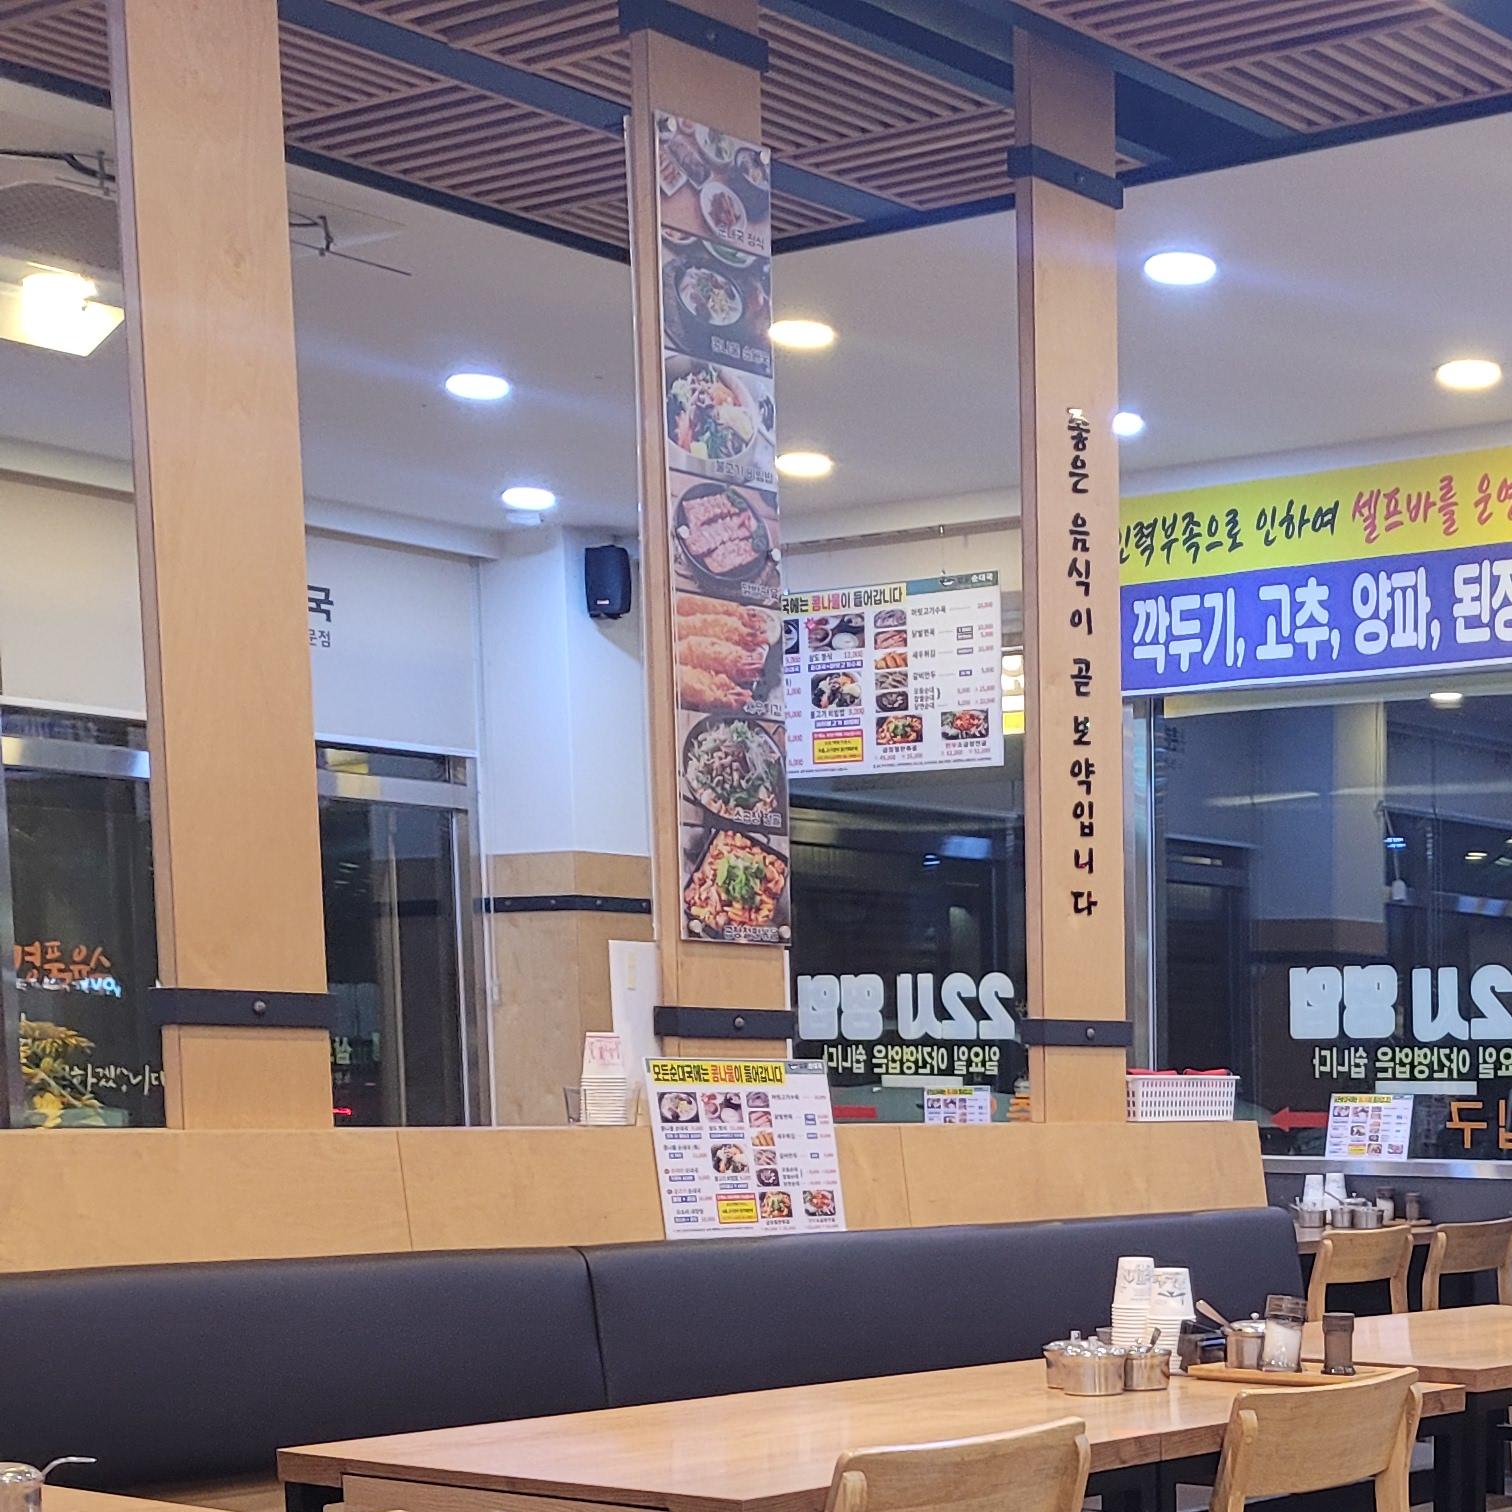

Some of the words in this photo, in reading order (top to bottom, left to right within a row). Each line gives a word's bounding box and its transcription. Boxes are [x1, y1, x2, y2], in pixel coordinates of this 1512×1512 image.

[1066, 407, 1091, 494] 좋은
[1118, 503, 1242, 567] 인력부족으로
[1255, 500, 1339, 547] 인하여
[1352, 475, 1460, 544] 셀프바를
[853, 586, 903, 608] 들어갑니다
[1067, 512, 1094, 636] 음식이
[1132, 587, 1246, 674] 깍두기,
[1255, 577, 1340, 661] 고추,
[1352, 566, 1440, 655] 양파,
[1069, 657, 1094, 698] 곧
[1069, 715, 1098, 918] 보약입니다
[653, 1063, 710, 1083] 모든순대국에는
[745, 1065, 783, 1083] 들어갑니다
